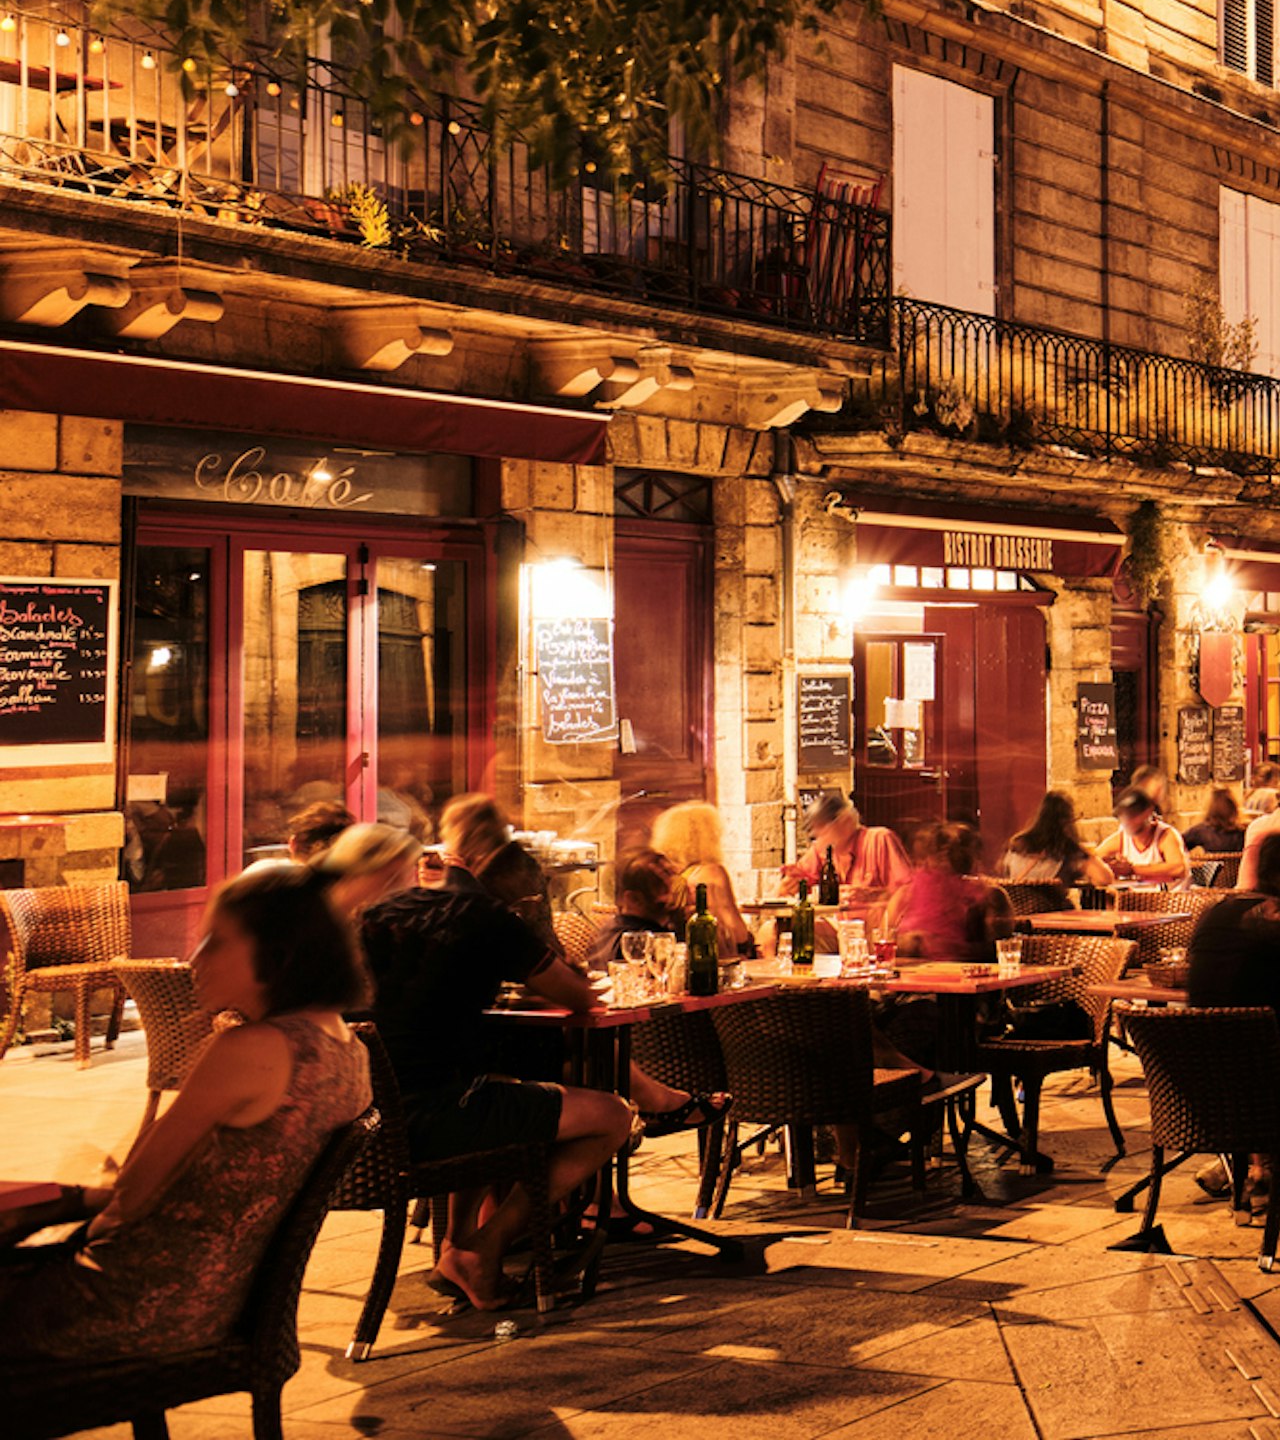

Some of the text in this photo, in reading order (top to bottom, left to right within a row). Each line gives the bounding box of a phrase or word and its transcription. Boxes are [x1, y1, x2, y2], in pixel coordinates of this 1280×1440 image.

[195, 446, 374, 508] Café
[944, 531, 1053, 571] BISTROT BRASSERIE
